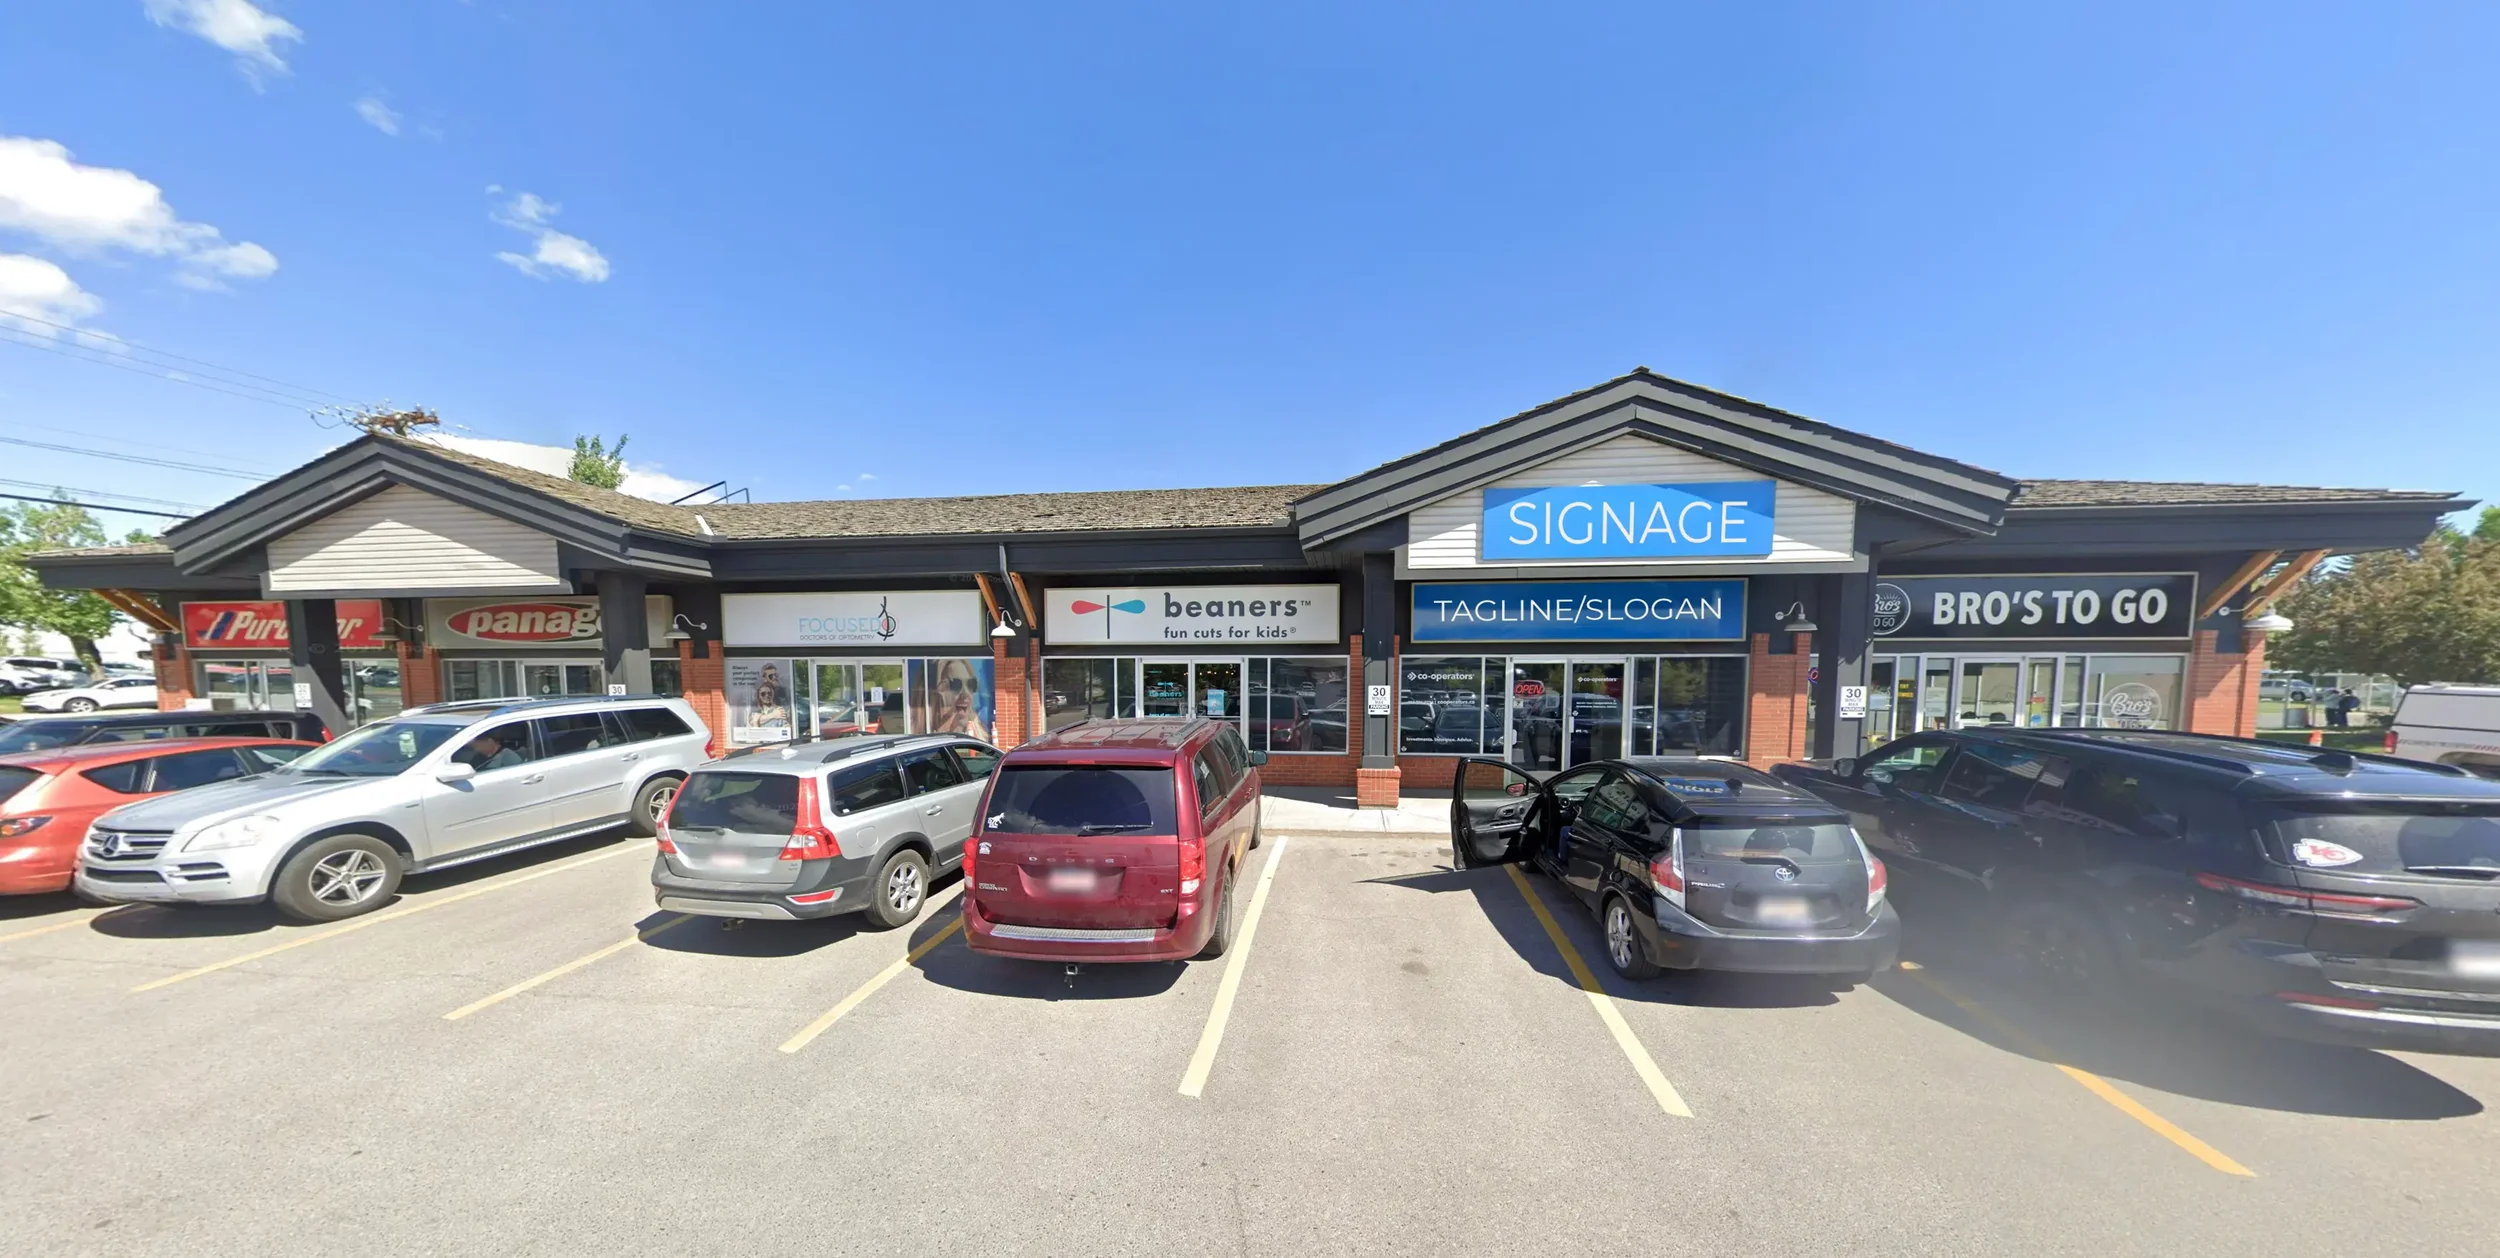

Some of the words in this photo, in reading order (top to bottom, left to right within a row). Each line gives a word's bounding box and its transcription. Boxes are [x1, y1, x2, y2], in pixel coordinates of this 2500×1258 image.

[1509, 501, 1748, 545] SIGNAGE
[1433, 595, 1722, 624] TAGLINE/SLOGAN
[1932, 589, 2045, 626] BRO'S
[2051, 589, 2100, 625] TO
[2111, 588, 2168, 625] GO
[467, 606, 603, 638] panag
[798, 617, 881, 633] FOCUSED
[1882, 617, 1895, 627] GO
[1164, 627, 1188, 639] fun
[1194, 627, 1223, 638] cuts
[1228, 626, 1251, 638] for
[1417, 672, 1475, 682] co-operators
[611, 685, 623, 695] 30
[1372, 687, 1386, 697] 30
[1515, 684, 1543, 695] OPEN
[1845, 688, 1862, 698] 30
[1028, 856, 1115, 865] DODGE
